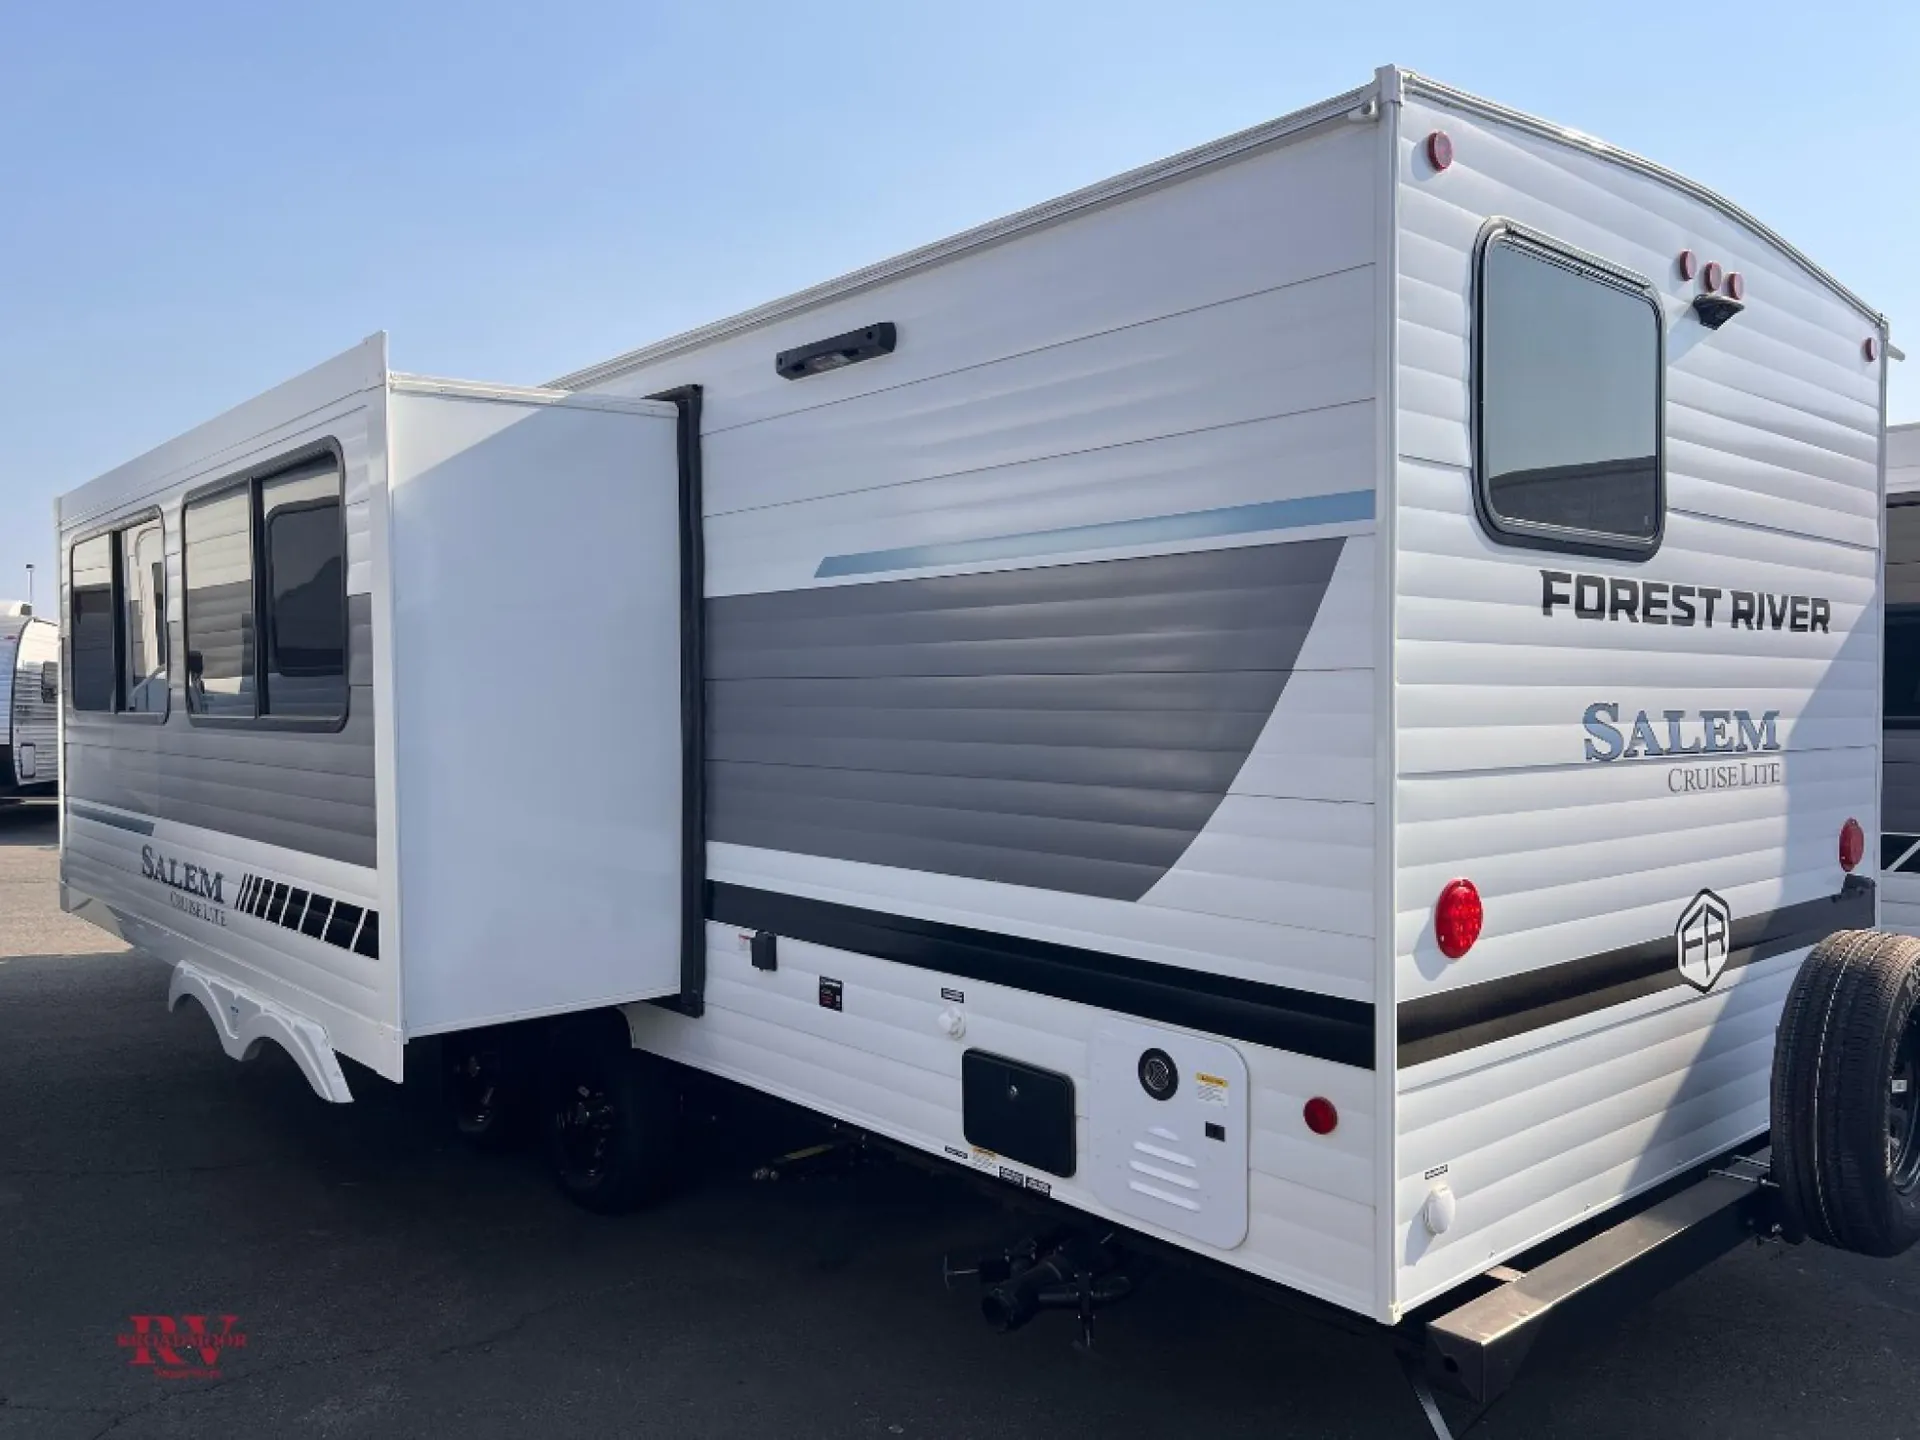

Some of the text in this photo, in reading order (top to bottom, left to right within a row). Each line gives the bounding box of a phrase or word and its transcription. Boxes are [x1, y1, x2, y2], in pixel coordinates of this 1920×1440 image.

[1539, 569, 1832, 634] FOREST RIVER
[1582, 702, 1781, 762] SALEM
[141, 843, 225, 904] SALEM
